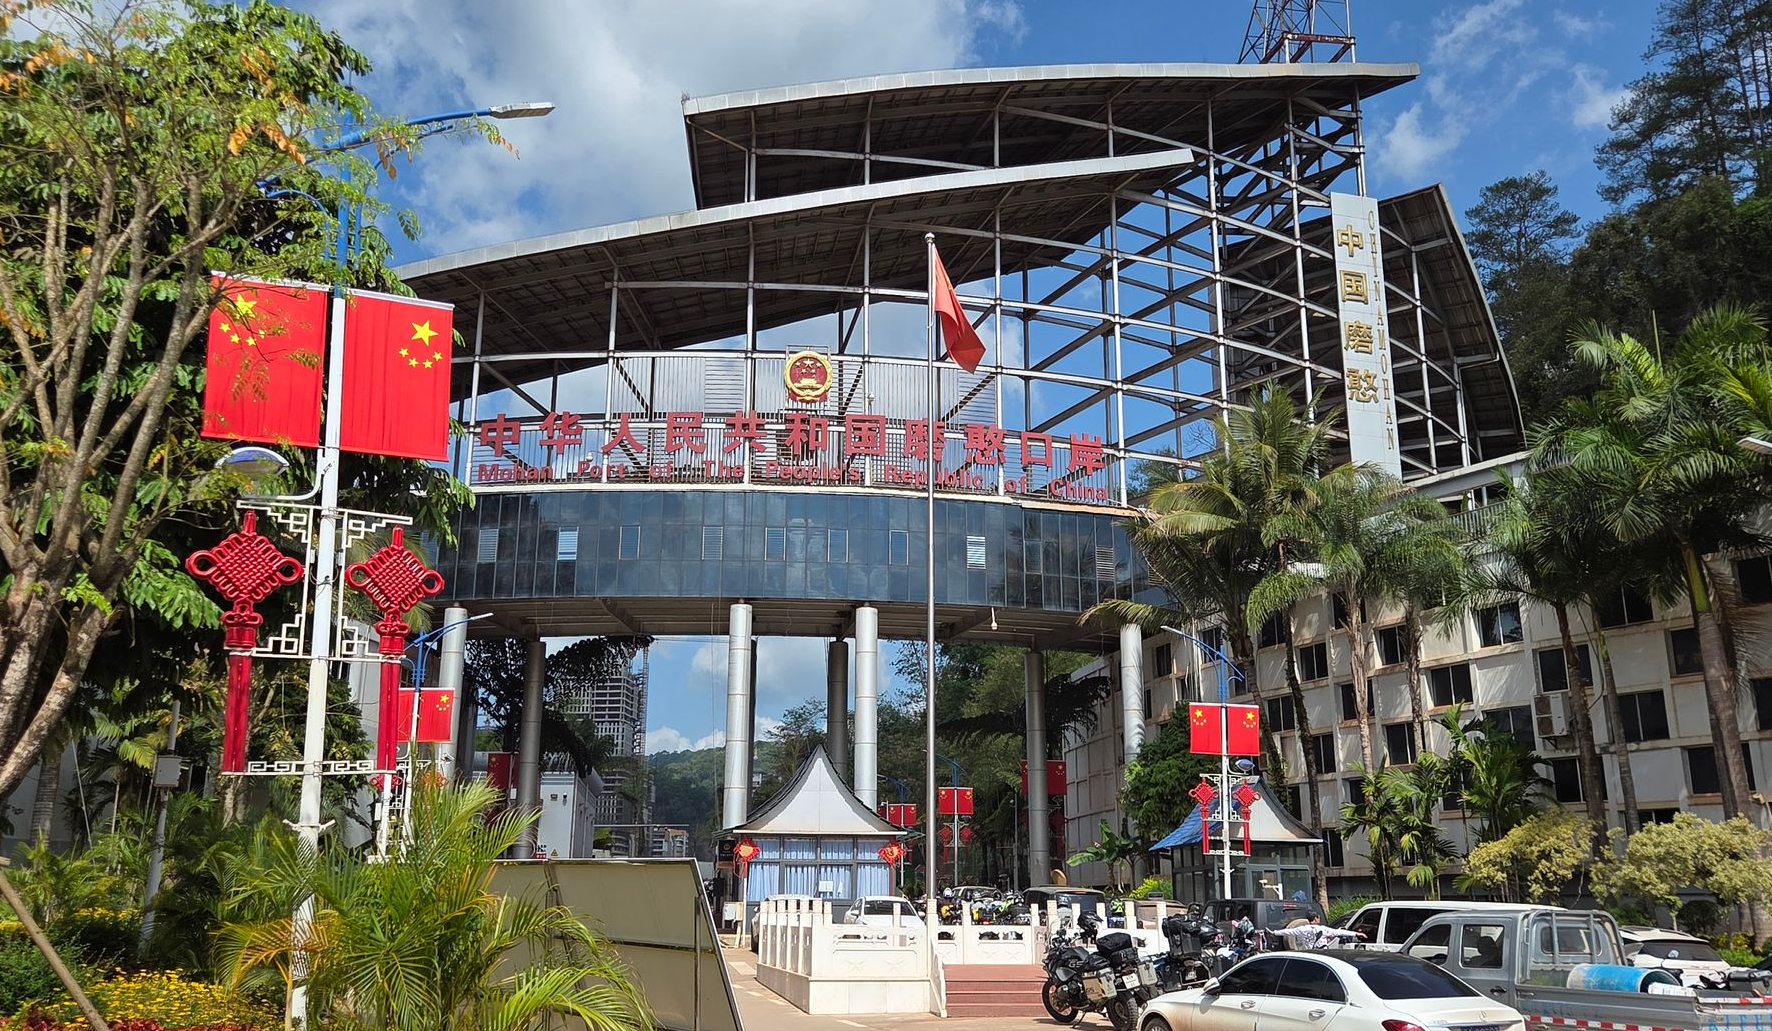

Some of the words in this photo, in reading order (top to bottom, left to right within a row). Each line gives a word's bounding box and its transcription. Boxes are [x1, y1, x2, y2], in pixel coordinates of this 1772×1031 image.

[1337, 224, 1379, 404] 中国磨憨
[480, 410, 1106, 476] 中华人民共和国磨憨口岸
[477, 463, 553, 482] Mohan
[577, 460, 626, 478] Port
[649, 460, 675, 478] of
[701, 461, 745, 478] The
[766, 461, 861, 482] People's
[1005, 476, 1028, 493] of
[1049, 478, 1107, 501] China
